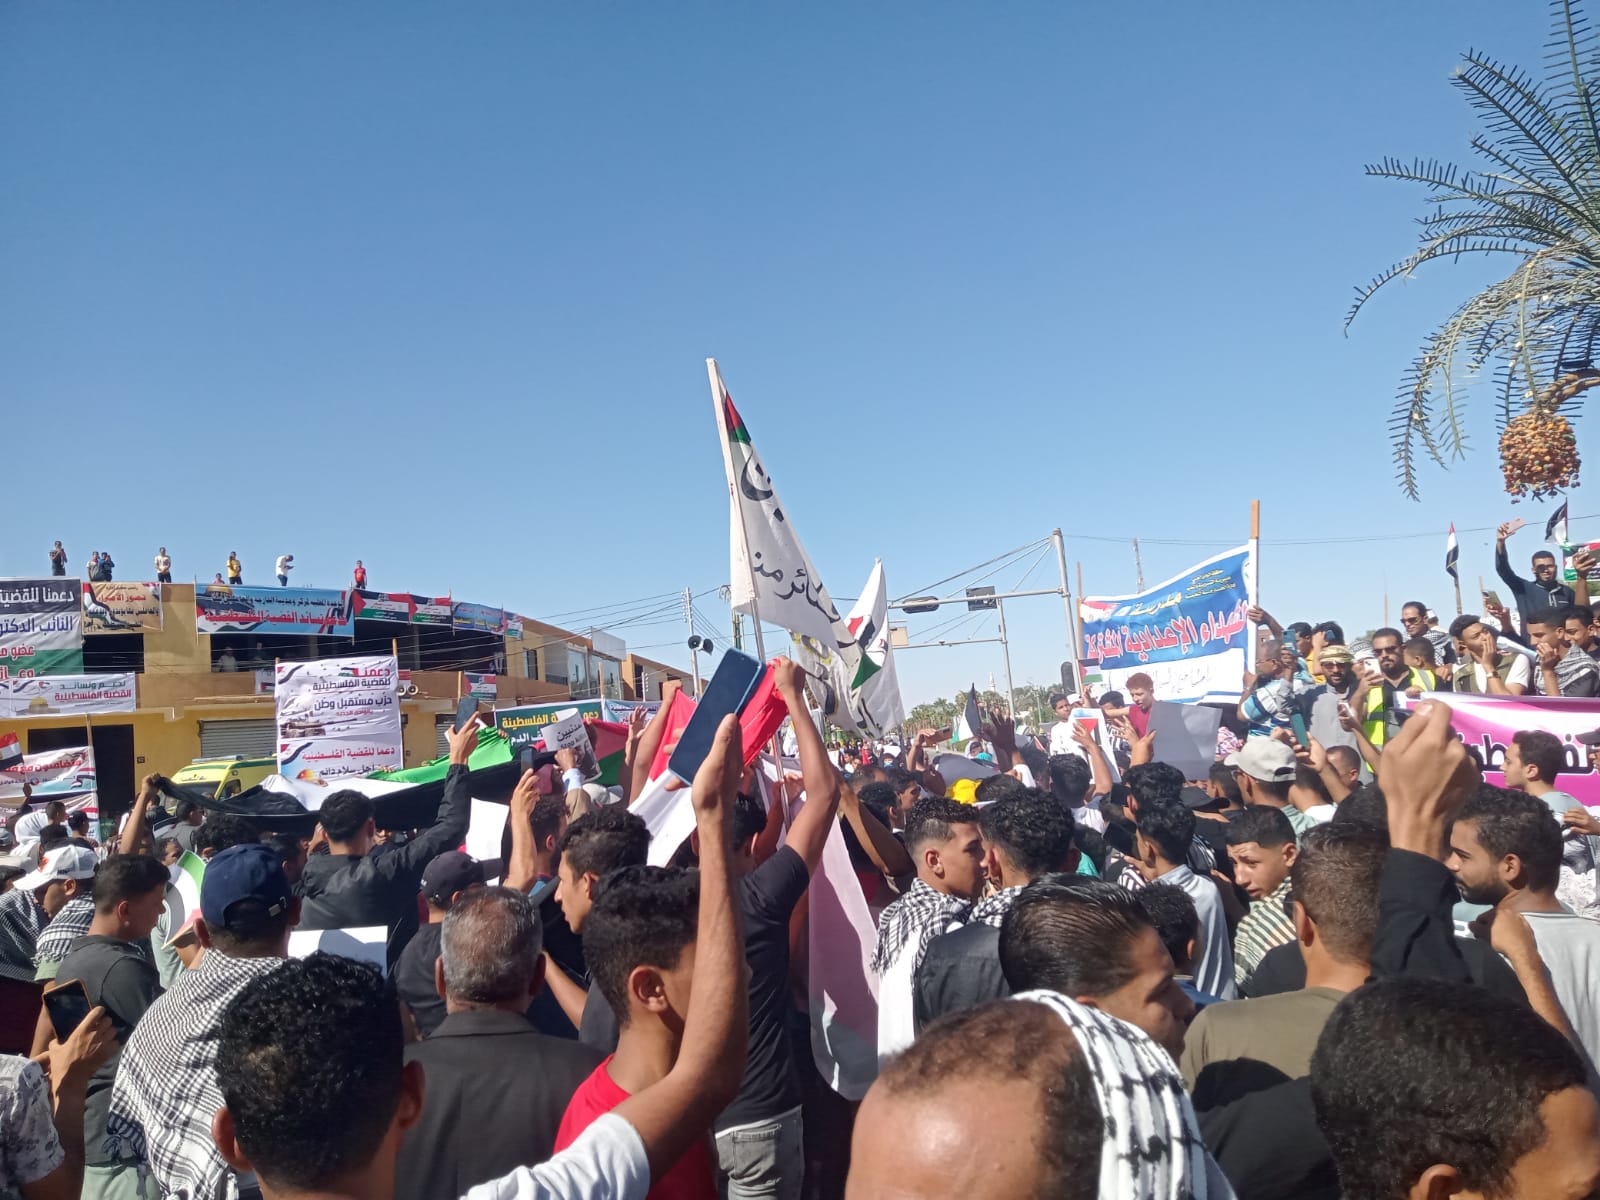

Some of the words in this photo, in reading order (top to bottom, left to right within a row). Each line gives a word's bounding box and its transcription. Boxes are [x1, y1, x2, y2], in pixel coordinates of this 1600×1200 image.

[43, 587, 74, 603] دعمنا
[1128, 592, 1182, 616] مدرسة
[39, 615, 73, 636] النائب
[1200, 599, 1248, 647] الشهداء
[1121, 616, 1198, 661] الإعدادية
[11, 643, 35, 660] عضو
[313, 678, 359, 691] الفلسطينية
[361, 677, 391, 689] للقضية
[54, 690, 102, 703] الفلسطينية
[103, 689, 132, 700] القضية
[375, 692, 393, 707] حزب
[314, 698, 336, 711] وطن
[337, 696, 374, 710] مستقبل
[510, 732, 530, 746] الدم
[347, 746, 374, 760] للقضية
